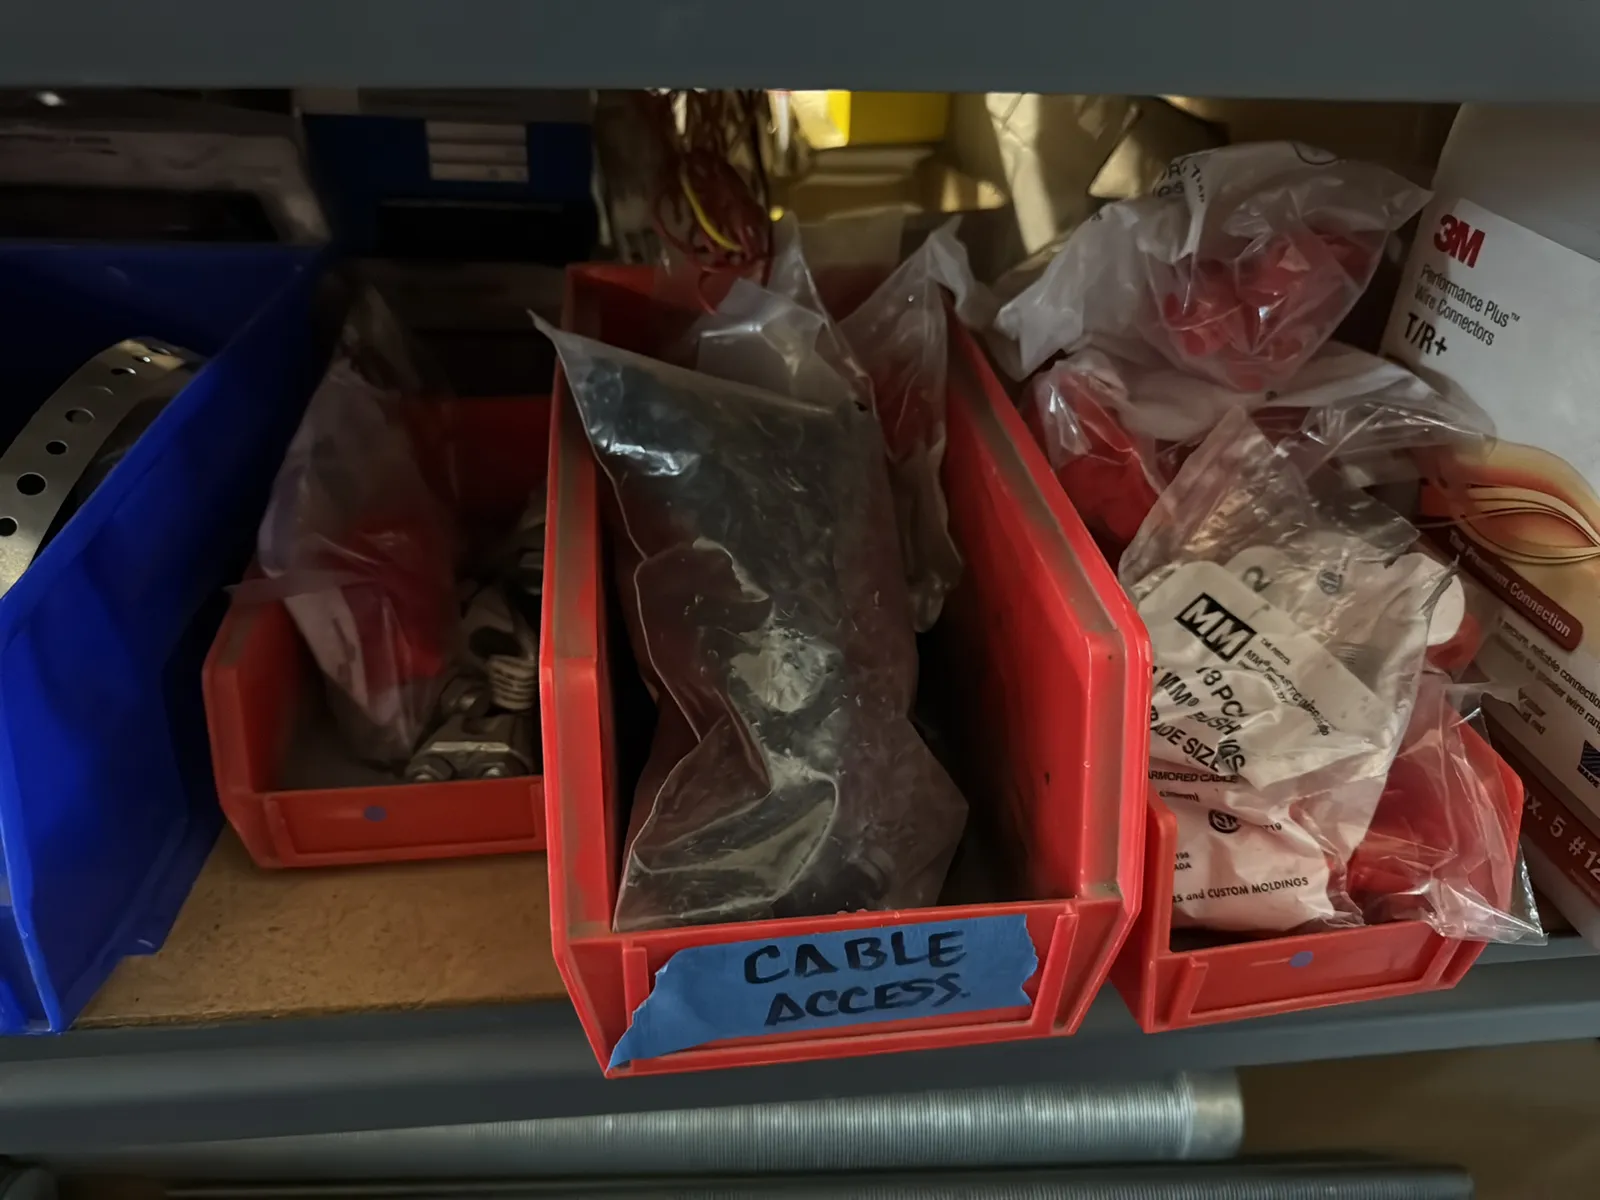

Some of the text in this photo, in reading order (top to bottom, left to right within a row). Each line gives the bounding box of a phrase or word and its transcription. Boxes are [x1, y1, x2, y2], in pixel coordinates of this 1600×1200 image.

[1434, 214, 1486, 268] 3M
[1421, 263, 1484, 313] Performance
[1404, 312, 1448, 356] T/R+
[1414, 283, 1496, 346] Wire Connectors
[1510, 581, 1572, 638] Connection
[1560, 669, 1600, 709] connectio
[1566, 694, 1585, 715] wire
[1550, 814, 1567, 838] 5
[1186, 889, 1205, 901] and
[1207, 885, 1249, 898] CUSTOM
[1252, 877, 1309, 894] MOLDINGS
[744, 930, 966, 984] CABLE
